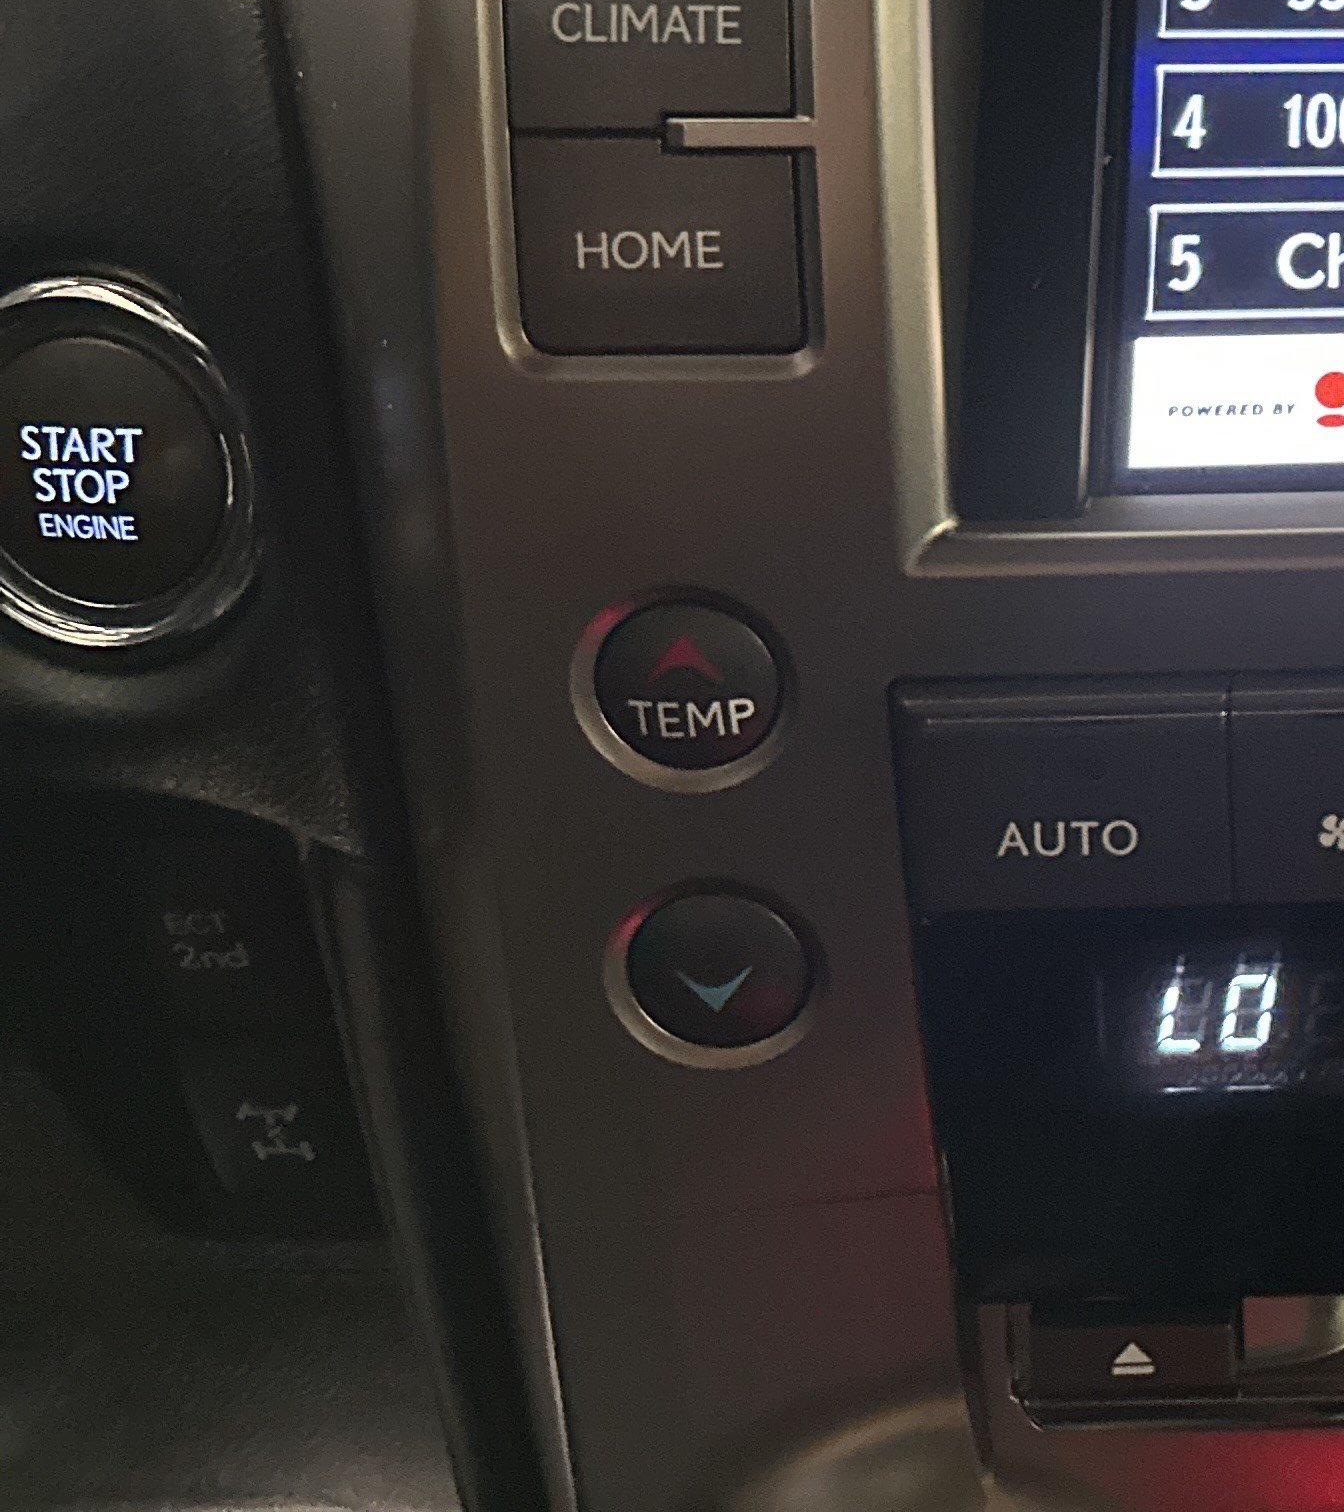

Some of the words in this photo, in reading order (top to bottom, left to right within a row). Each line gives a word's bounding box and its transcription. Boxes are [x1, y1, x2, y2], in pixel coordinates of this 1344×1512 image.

[550, 3, 743, 45] CLIMATE
[1173, 94, 1206, 148] 4
[576, 230, 725, 269] HOME
[1168, 235, 1201, 292] 5
[1167, 403, 1264, 417] POWERED
[1272, 403, 1297, 415] BY
[20, 425, 143, 465] START
[32, 468, 131, 505] STOP
[38, 513, 139, 542] ENGINE
[627, 697, 758, 741] TEMP
[996, 819, 1140, 859] AUTO
